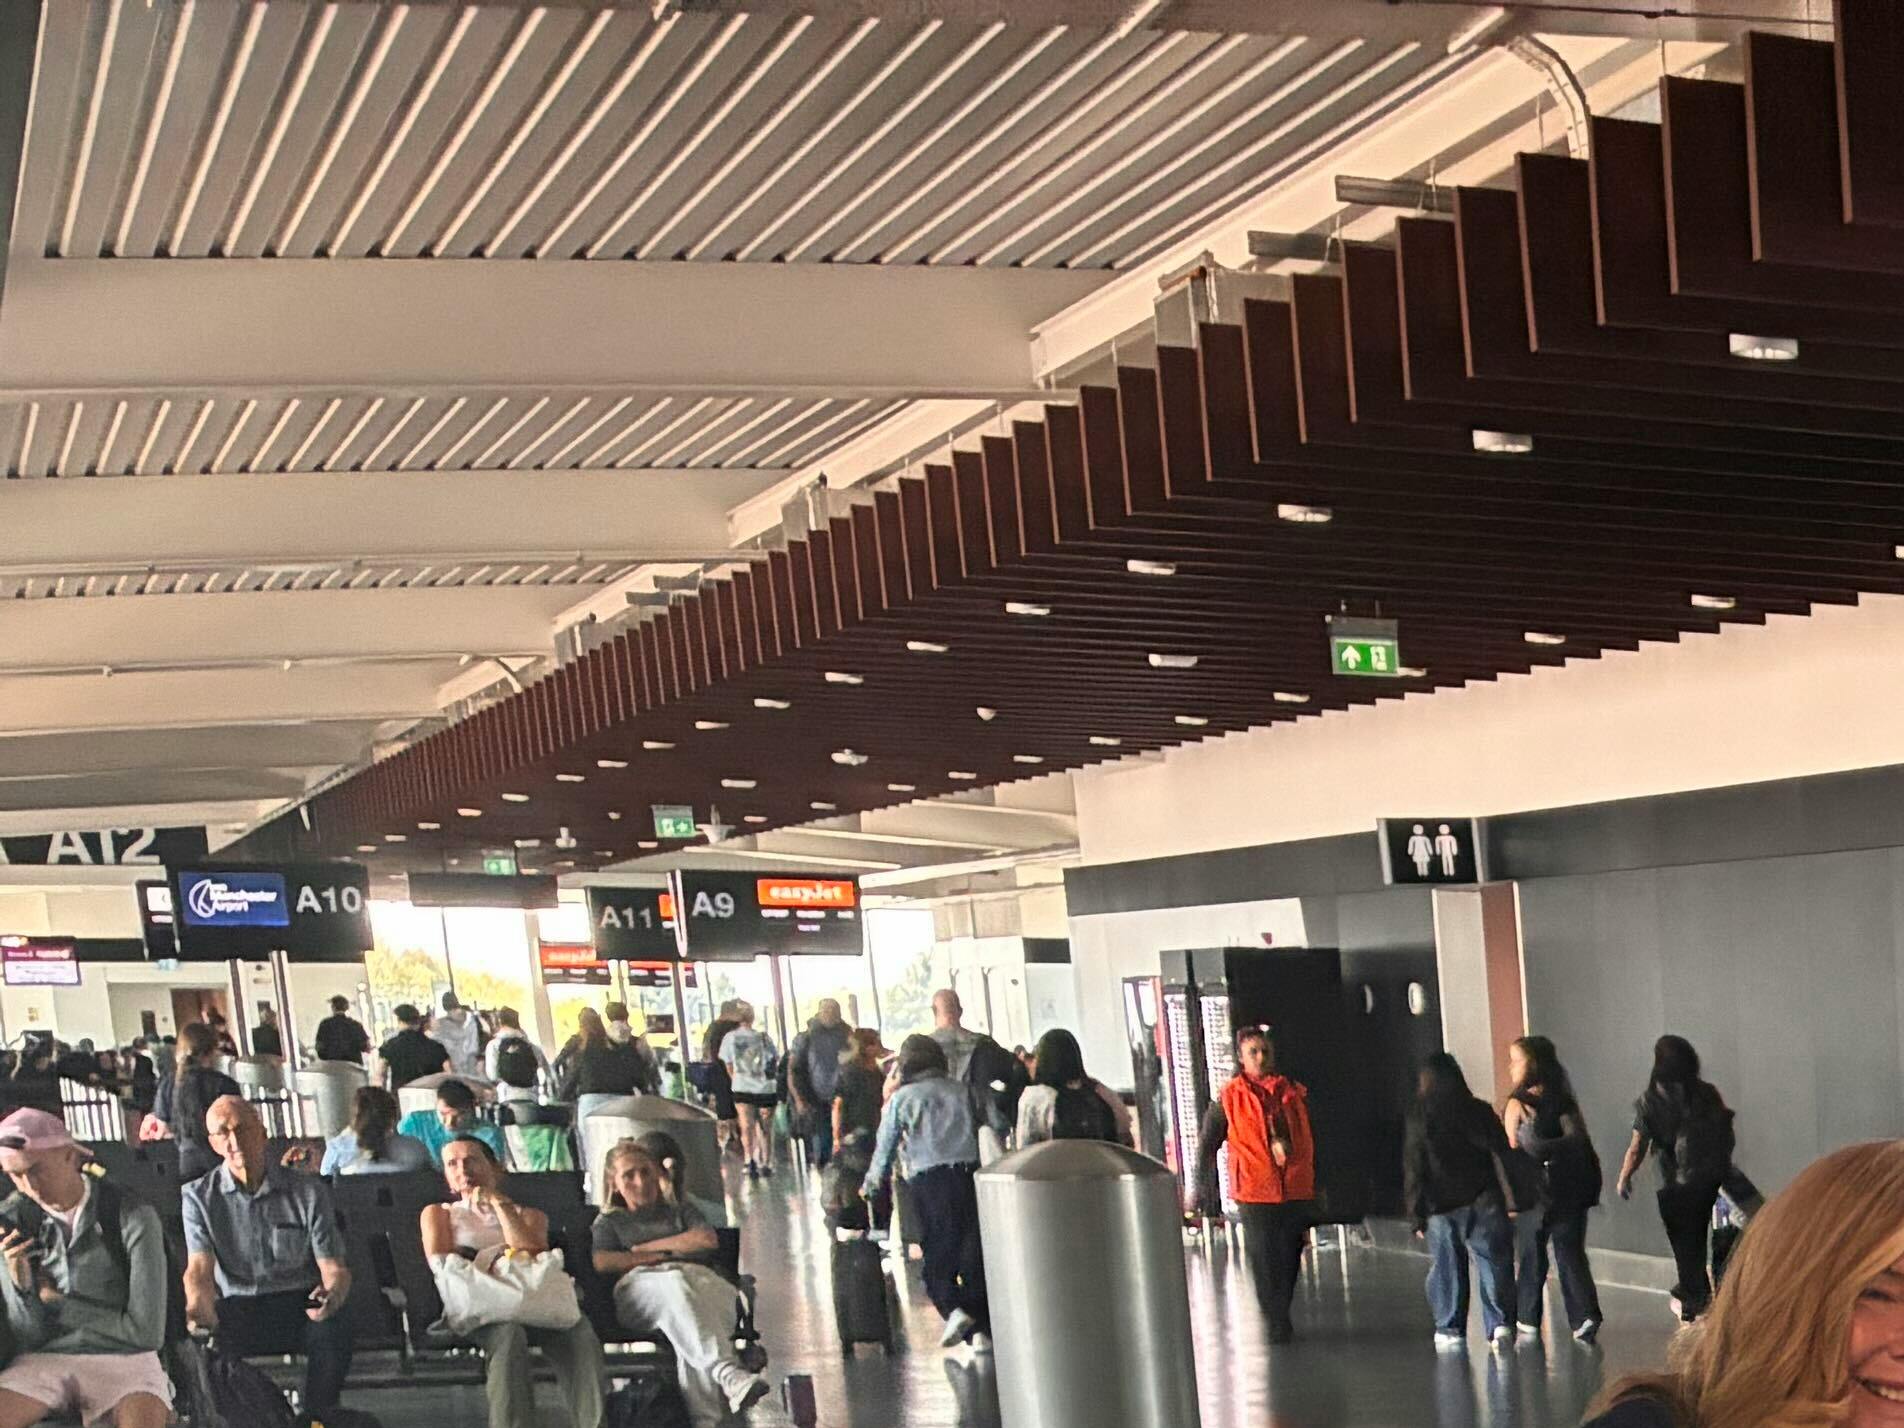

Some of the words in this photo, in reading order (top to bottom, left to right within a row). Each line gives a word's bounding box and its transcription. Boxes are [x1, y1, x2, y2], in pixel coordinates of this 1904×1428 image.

[47, 829, 160, 864] A12
[296, 886, 361, 913] A10
[691, 891, 735, 918] A9
[769, 882, 843, 903] easyJet
[599, 905, 652, 928] A11
